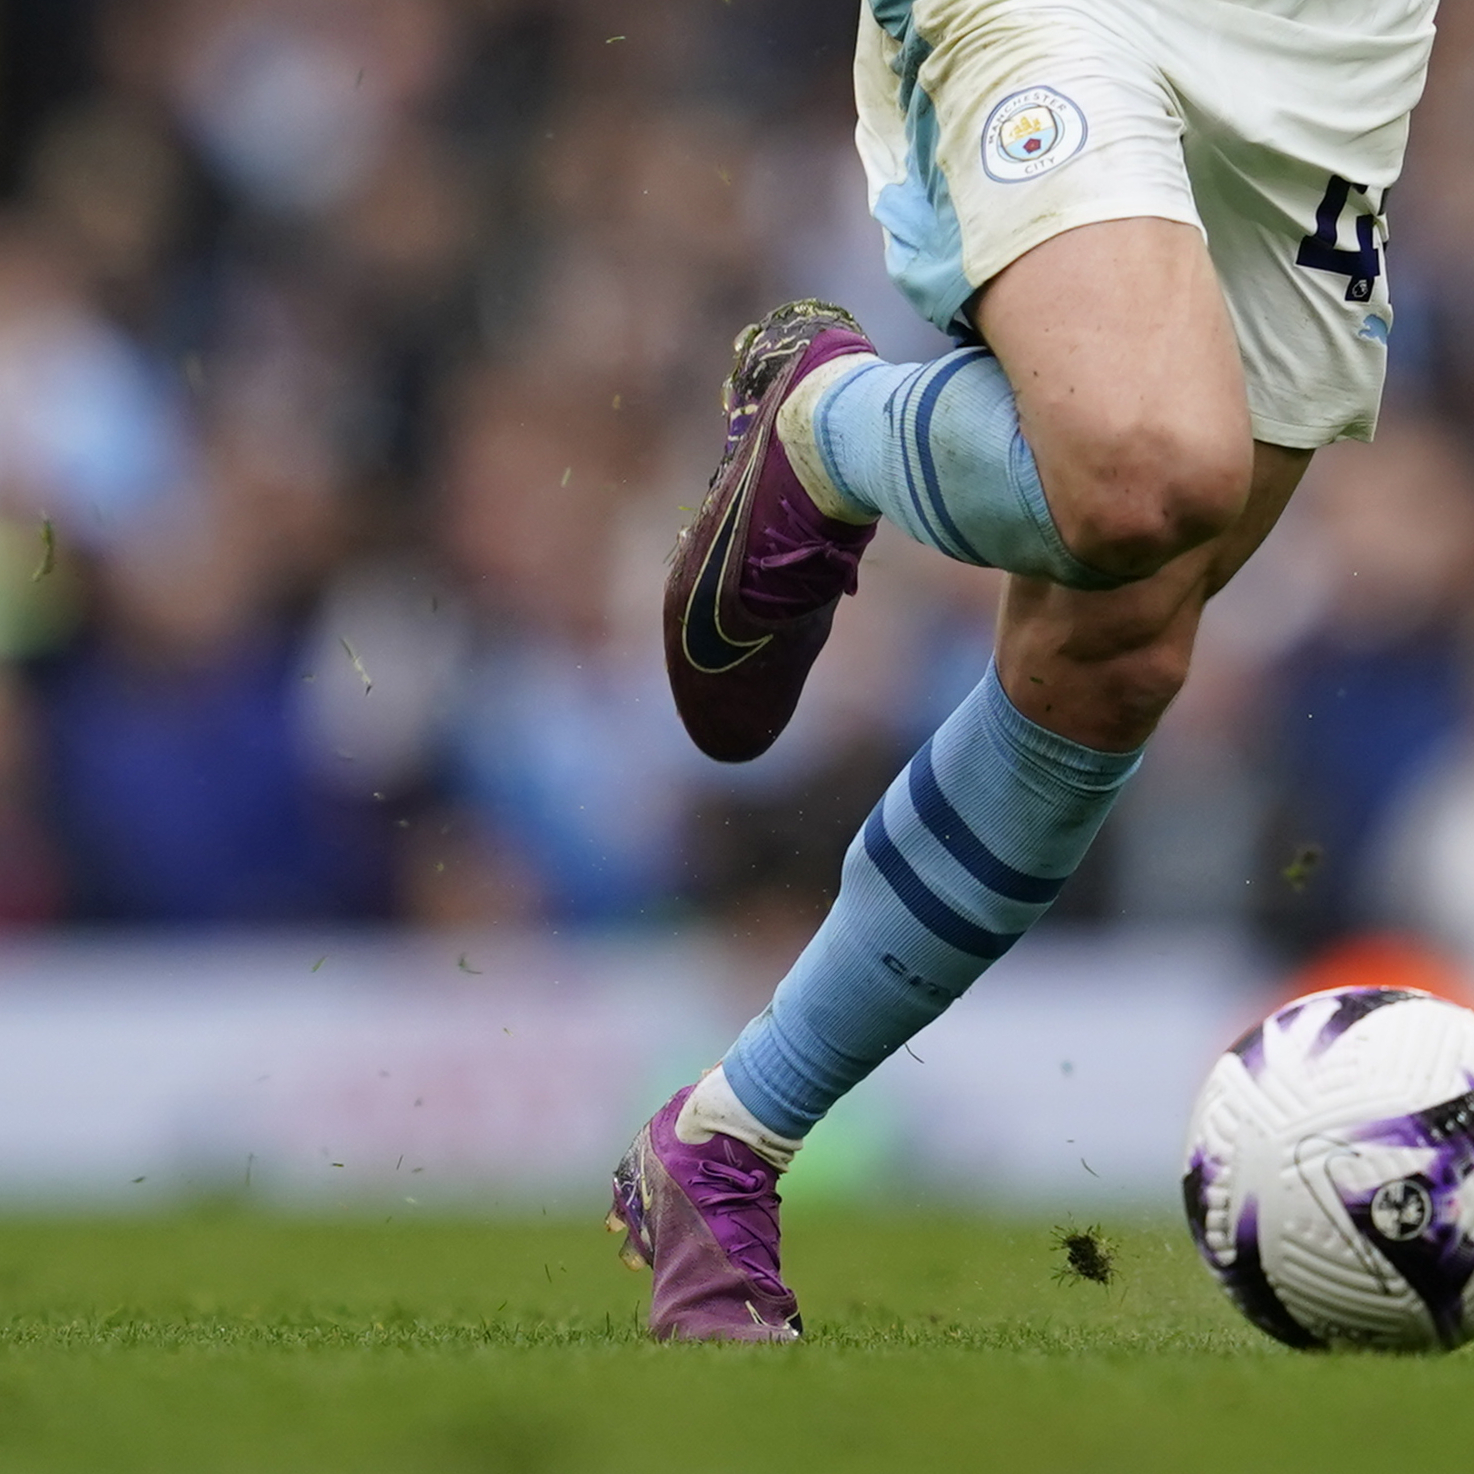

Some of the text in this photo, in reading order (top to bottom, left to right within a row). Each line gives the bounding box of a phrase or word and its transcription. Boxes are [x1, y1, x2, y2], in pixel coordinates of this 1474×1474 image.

[988, 92, 1068, 145] MANCHESTER
[1024, 156, 1056, 175] CITY
[1295, 174, 1392, 302] 4
